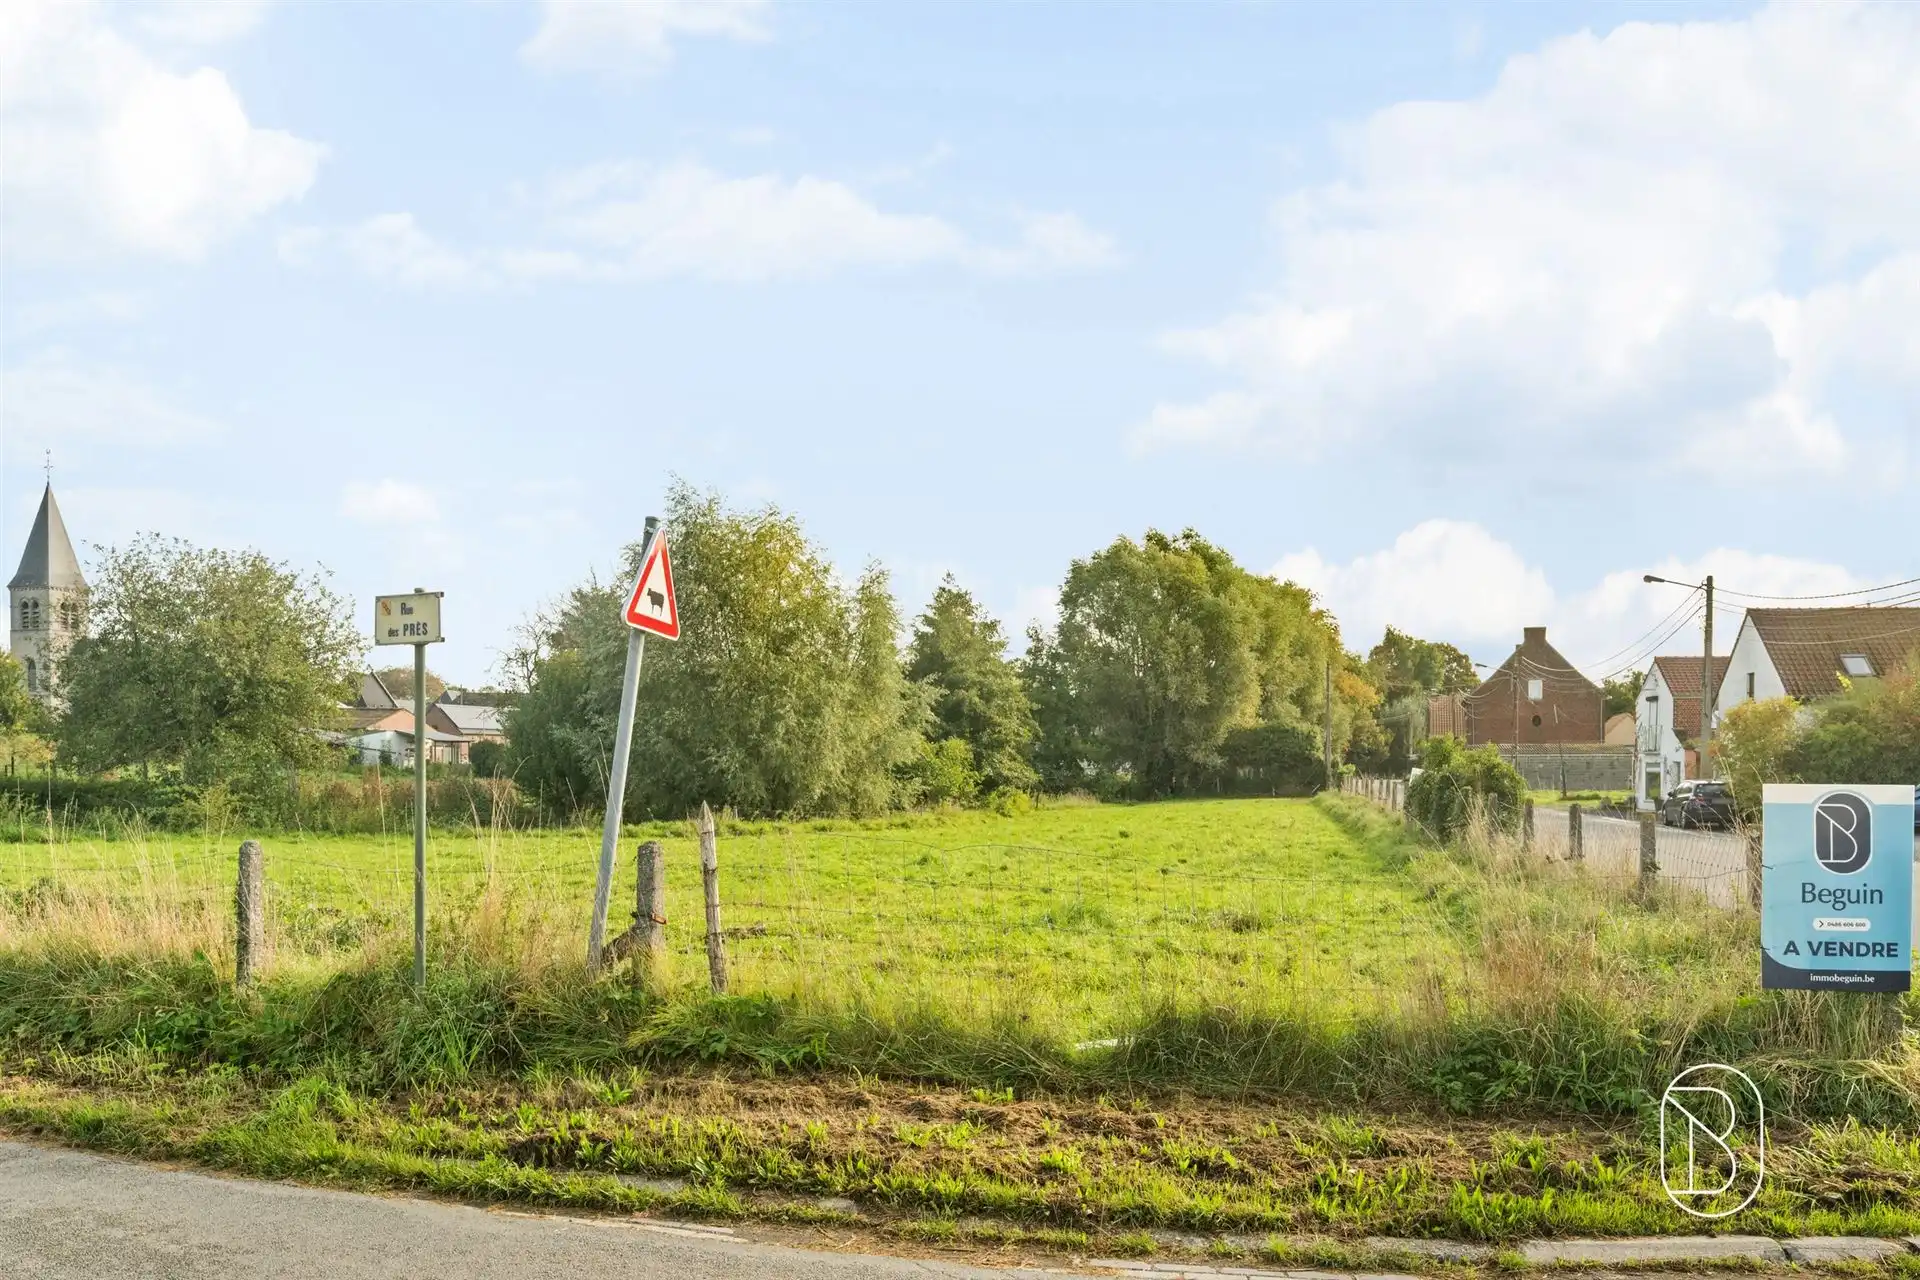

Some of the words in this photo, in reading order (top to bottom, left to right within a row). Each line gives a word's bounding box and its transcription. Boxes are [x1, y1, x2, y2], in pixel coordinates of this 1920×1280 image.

[400, 602, 413, 616] Rue
[388, 627, 399, 637] des
[1801, 882, 1884, 911] Beguin
[1783, 940, 1801, 956] A
[1807, 940, 1899, 958] VENDRE
[1809, 973, 1877, 985] immobeguin.be
